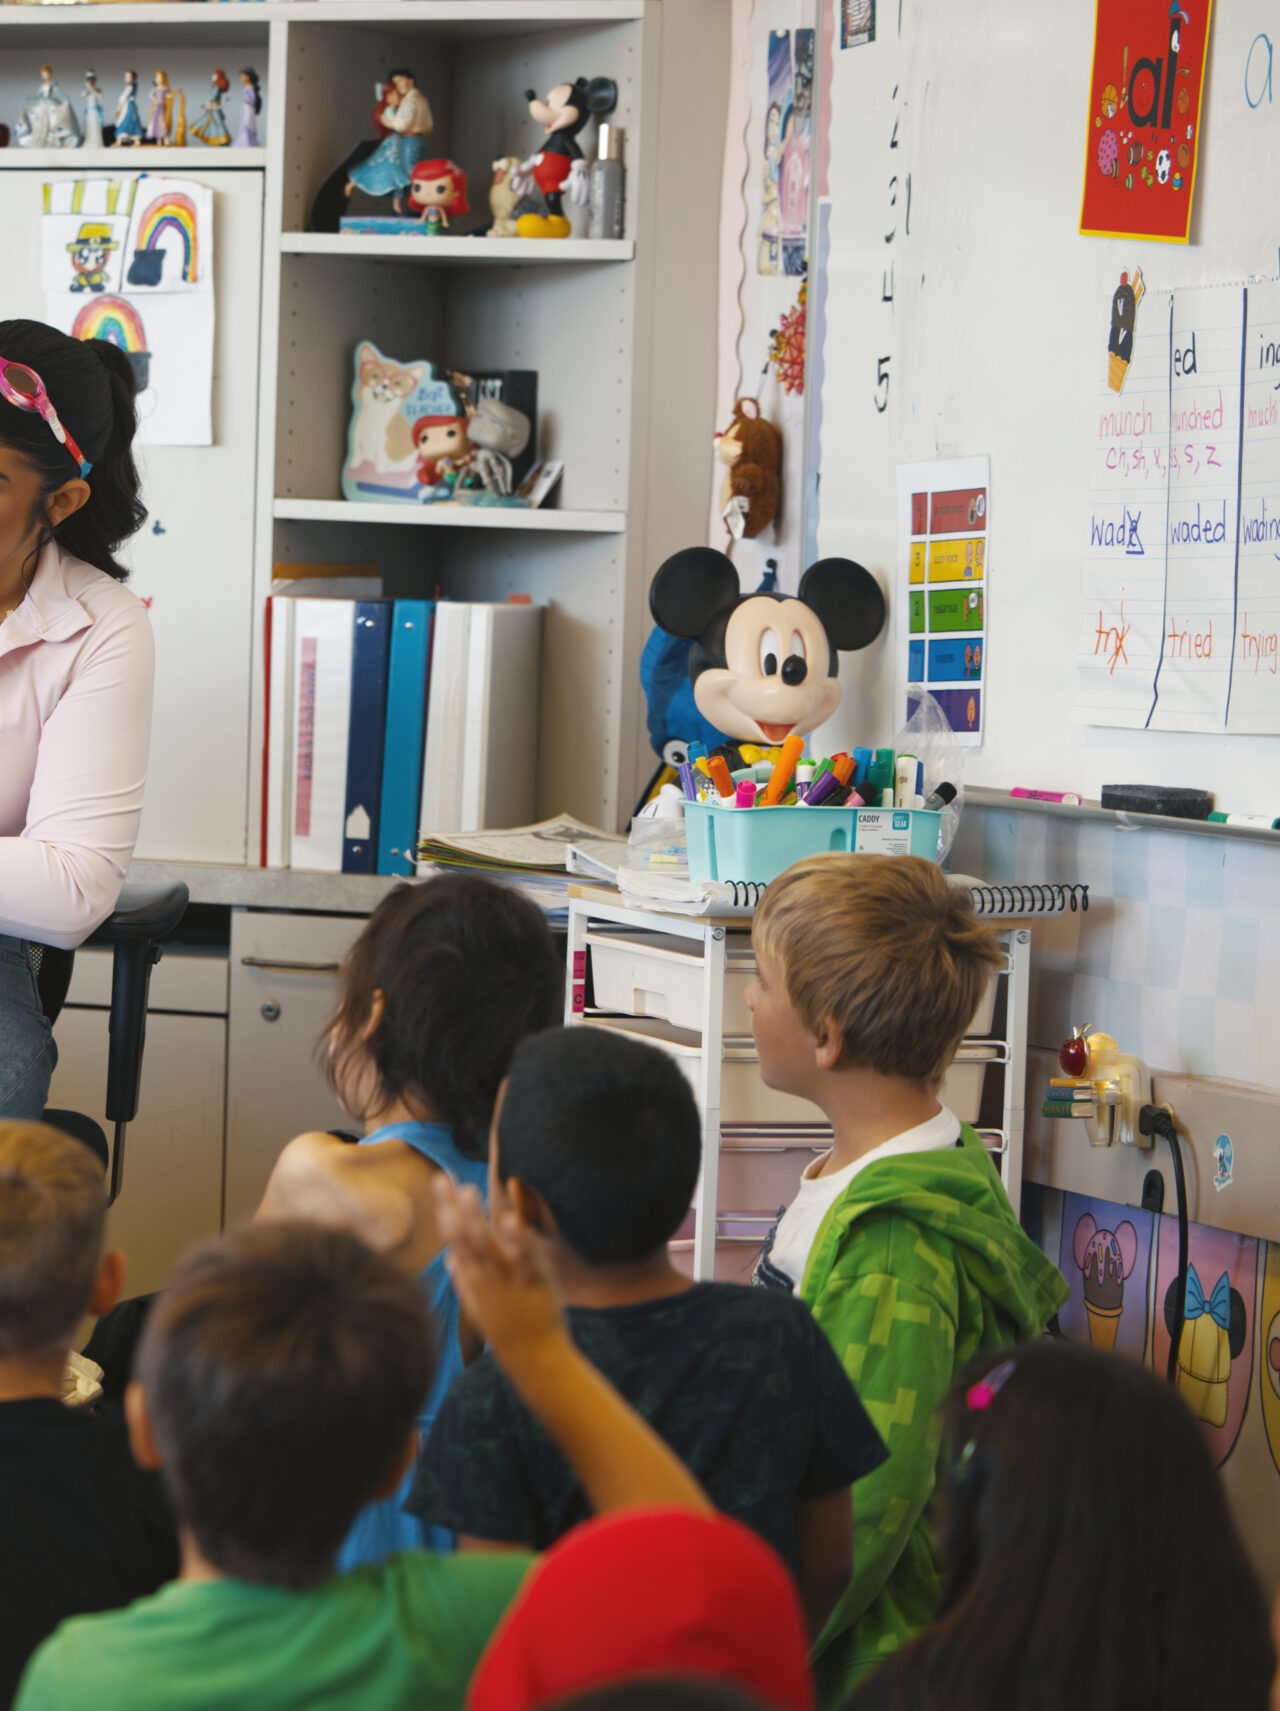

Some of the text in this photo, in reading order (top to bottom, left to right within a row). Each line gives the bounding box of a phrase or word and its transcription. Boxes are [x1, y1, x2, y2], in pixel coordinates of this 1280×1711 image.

[1128, 17, 1181, 129] al
[1173, 331, 1197, 377] ed
[874, 356, 891, 413] 5
[1099, 398, 1152, 440] munch
[1171, 499, 1226, 545] waded
[1168, 616, 1213, 660] tried
[1242, 611, 1278, 676] trying
[858, 814, 880, 824] CADDY
[574, 993, 583, 1005] C
